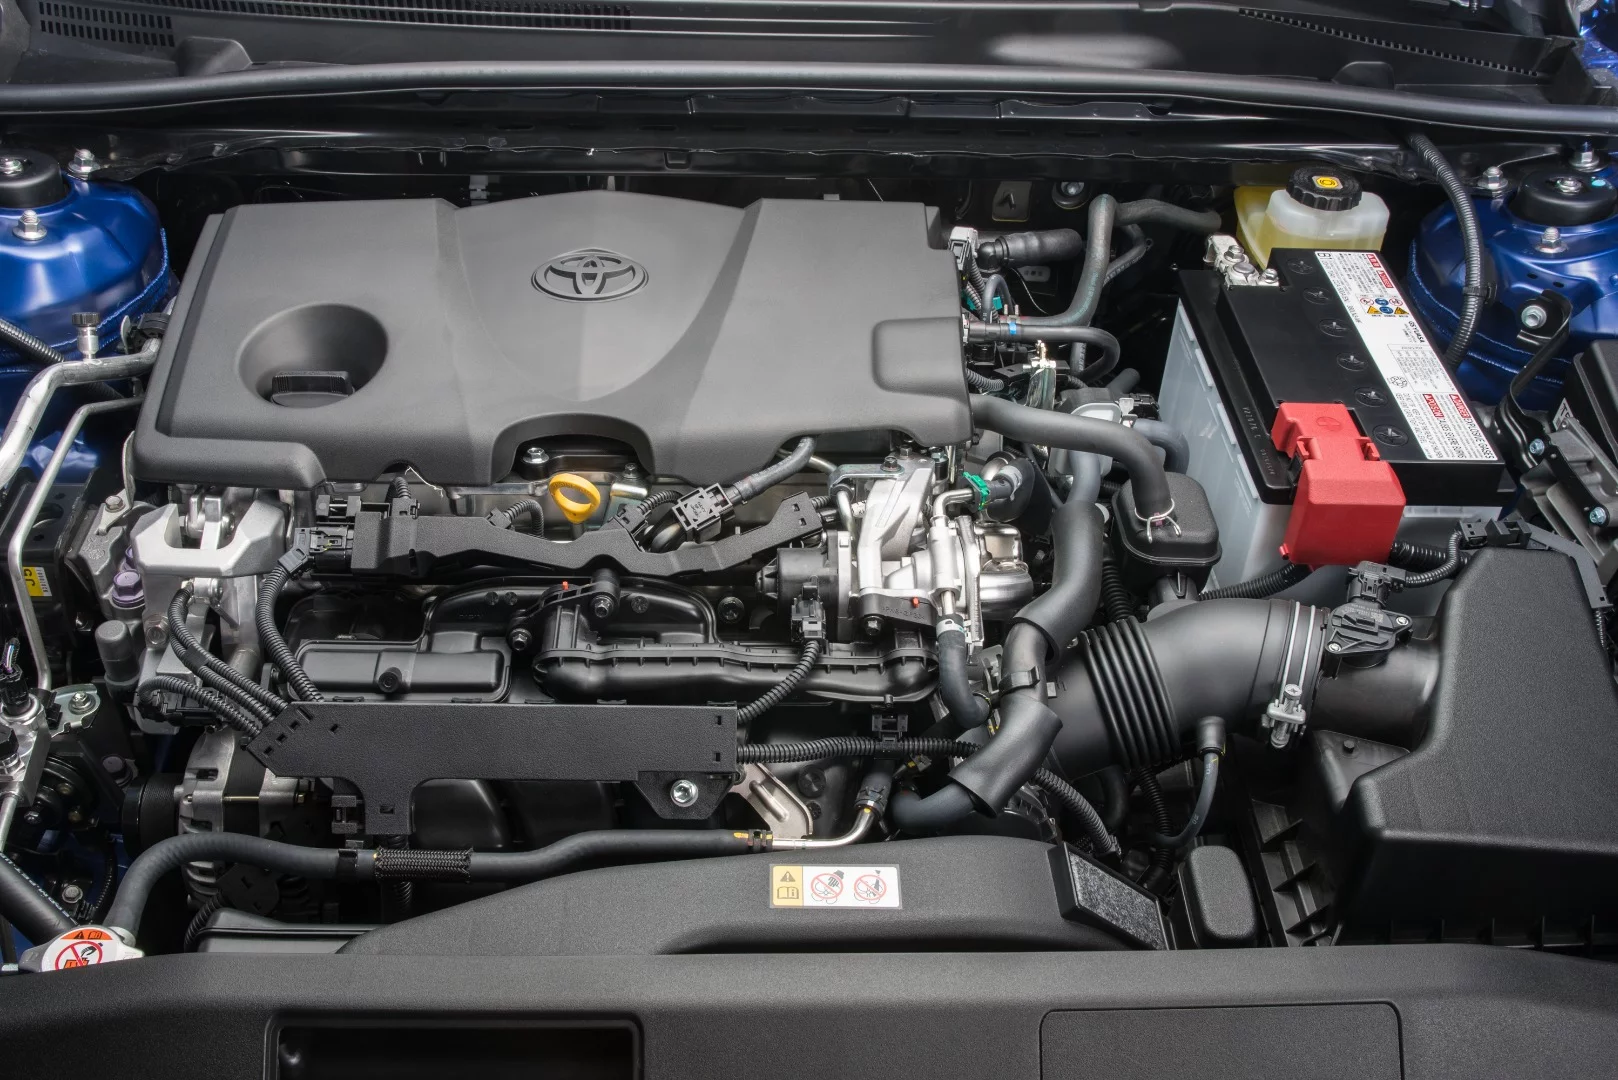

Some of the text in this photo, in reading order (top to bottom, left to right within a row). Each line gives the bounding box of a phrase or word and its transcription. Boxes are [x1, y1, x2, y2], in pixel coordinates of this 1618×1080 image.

[1425, 399, 1444, 417] POISON
[1453, 400, 1495, 459] DANGER EXPLOSIVE GASES
